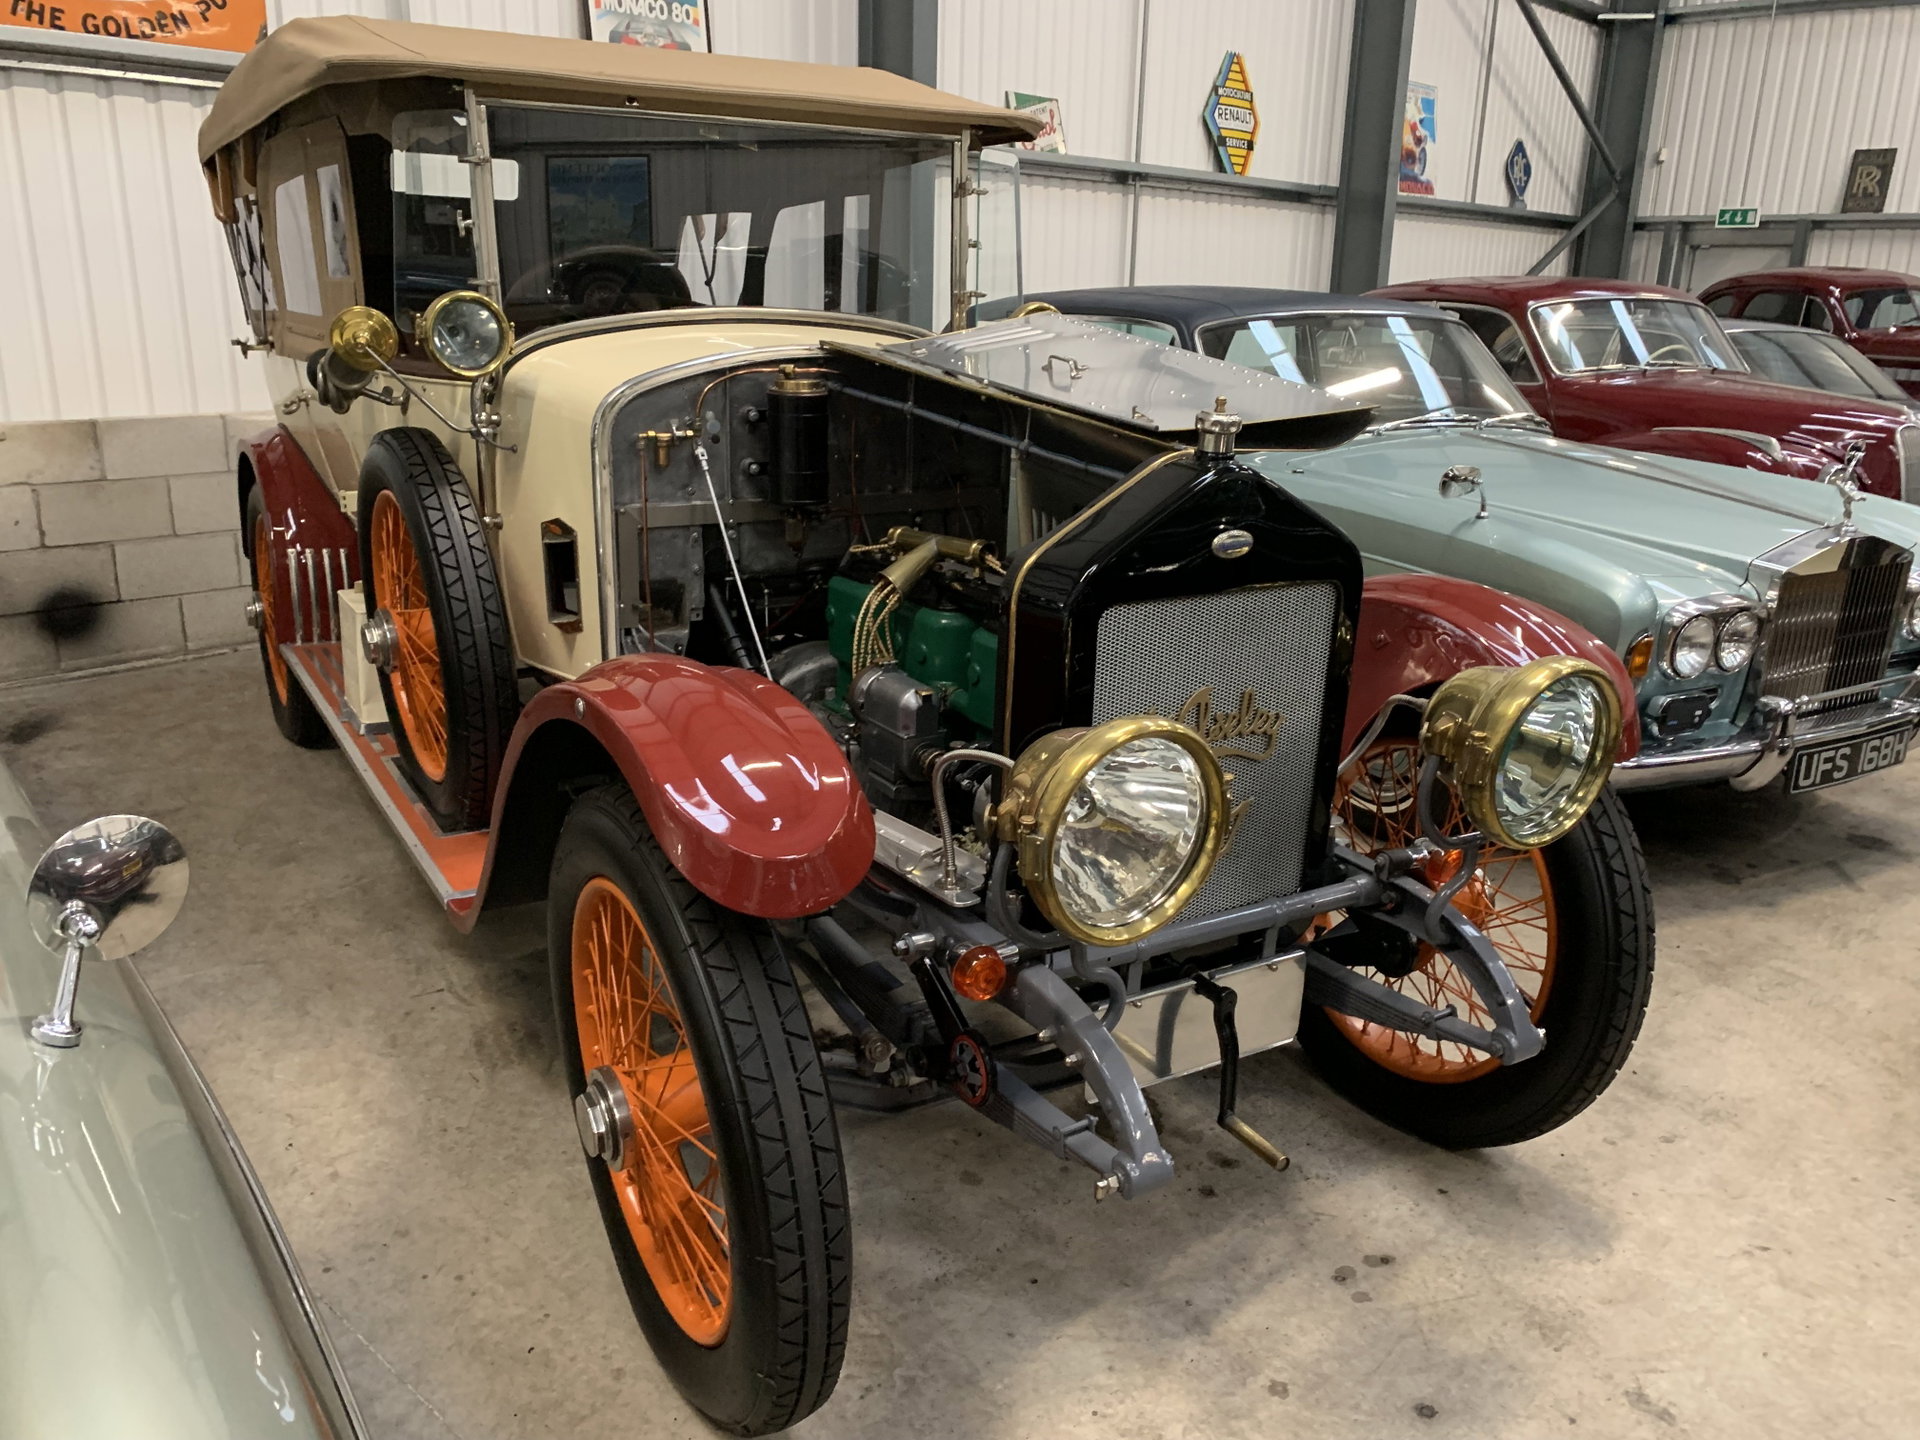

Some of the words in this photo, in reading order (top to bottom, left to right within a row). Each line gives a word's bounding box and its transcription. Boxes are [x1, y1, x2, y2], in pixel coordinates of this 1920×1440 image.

[10, 0, 65, 31] THE
[81, 10, 193, 39] GOLDEN
[602, 0, 668, 20] MONACO
[671, 2, 693, 24] 80
[1217, 107, 1252, 125] RENAULT
[1226, 137, 1248, 149] SERVICE
[1798, 747, 1851, 787] UFS
[1858, 730, 1909, 773] 168H
